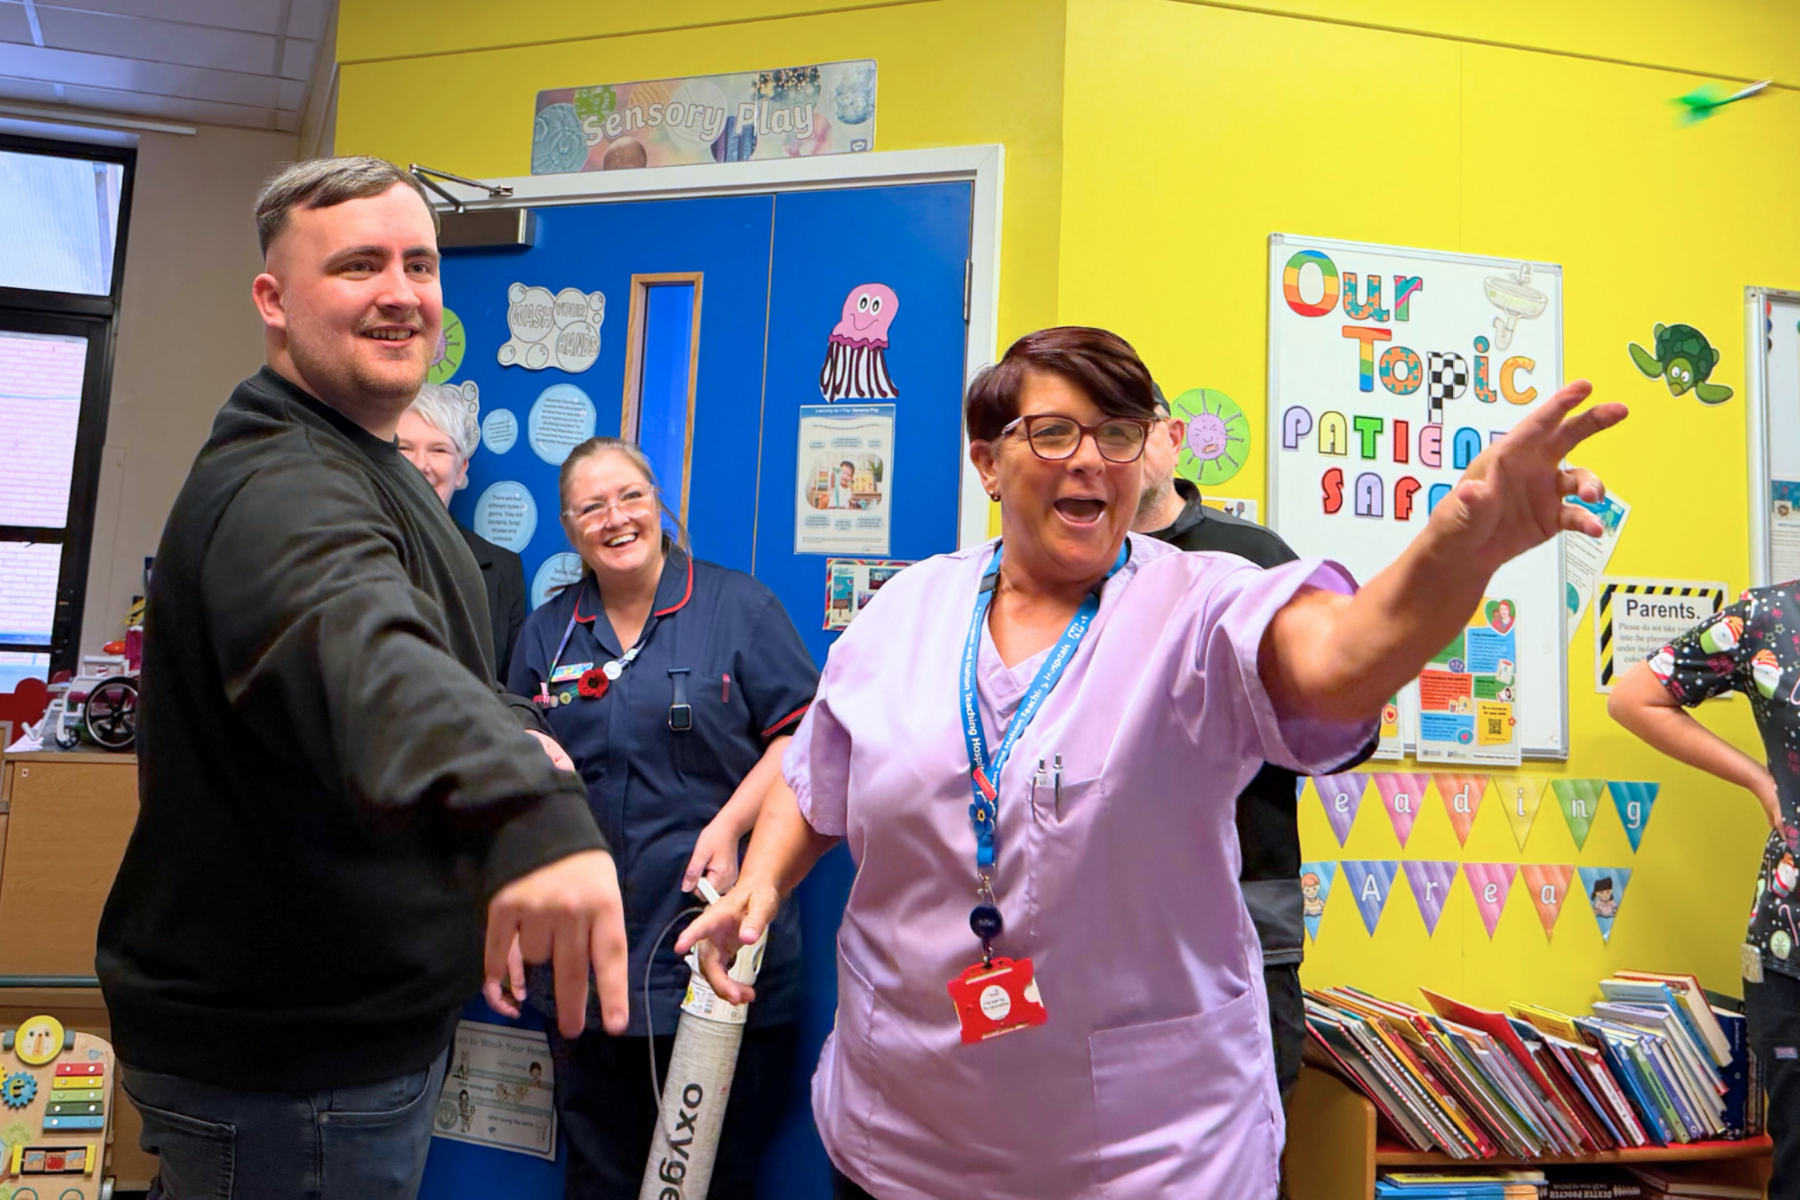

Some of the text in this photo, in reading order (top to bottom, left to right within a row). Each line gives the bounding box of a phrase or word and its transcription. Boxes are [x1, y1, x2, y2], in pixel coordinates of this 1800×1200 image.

[581, 98, 816, 148] Sensory Play
[1282, 249, 1423, 322] Our
[511, 303, 554, 329] WASH
[555, 301, 586, 318] YOUR
[557, 332, 600, 358] HANDS
[1341, 324, 1538, 424] Topic
[1282, 405, 1508, 469] PATIEN
[1625, 598, 1701, 620] Parents.
[1618, 622, 1641, 631] Please
[1641, 623, 1651, 631] do
[1662, 624, 1676, 632] take
[1634, 634, 1645, 642] the
[964, 661, 973, 691] Halton
[965, 691, 978, 736] Teaching
[971, 737, 986, 769] Hospit
[1360, 873, 1557, 905] Area
